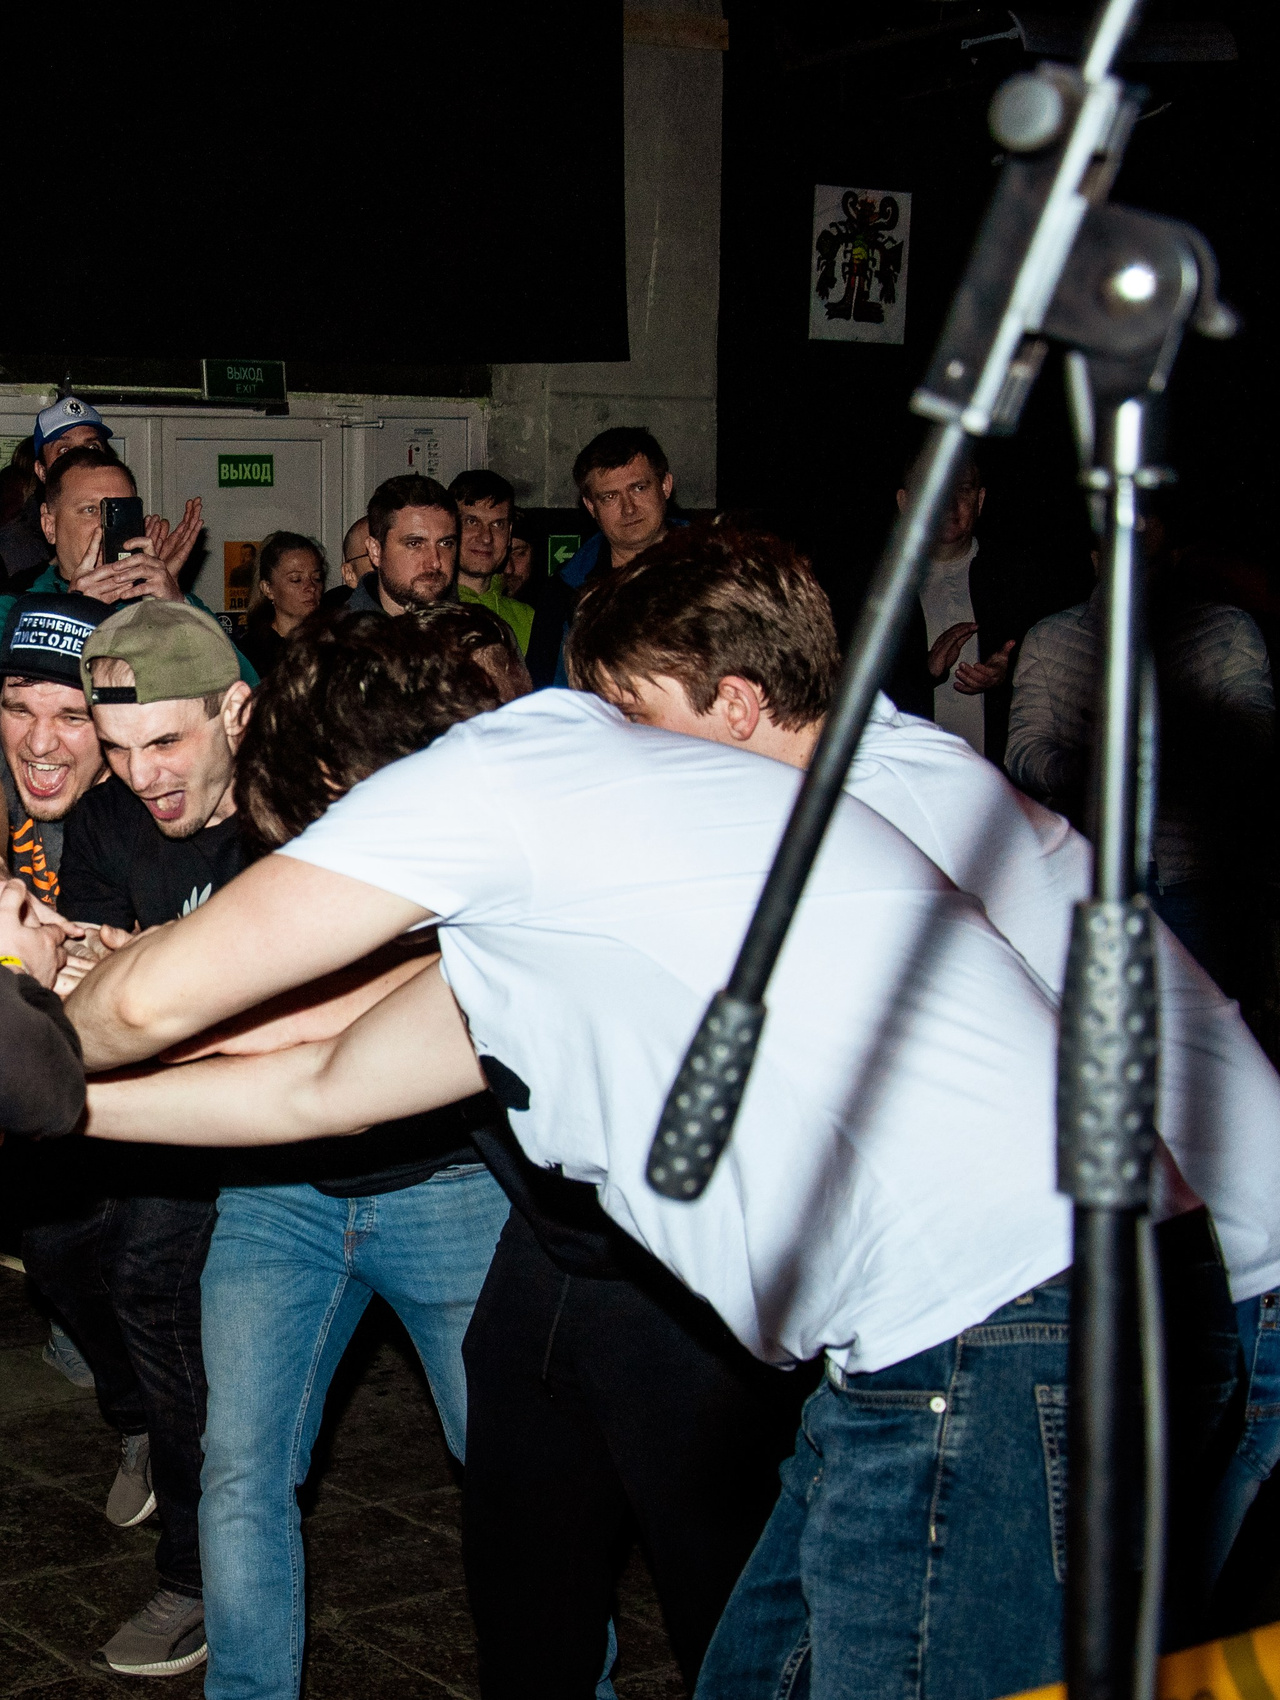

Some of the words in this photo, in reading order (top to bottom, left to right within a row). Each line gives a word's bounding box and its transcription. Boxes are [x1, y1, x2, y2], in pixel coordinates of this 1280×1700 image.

[226, 366, 264, 383] ВЫХОД
[236, 384, 256, 393] EXIT
[220, 463, 271, 482] ВЫХОД
[20, 617, 93, 638] ГРЕЧНЕВЫЙ
[14, 631, 84, 652] ПИСТОЛЕ
